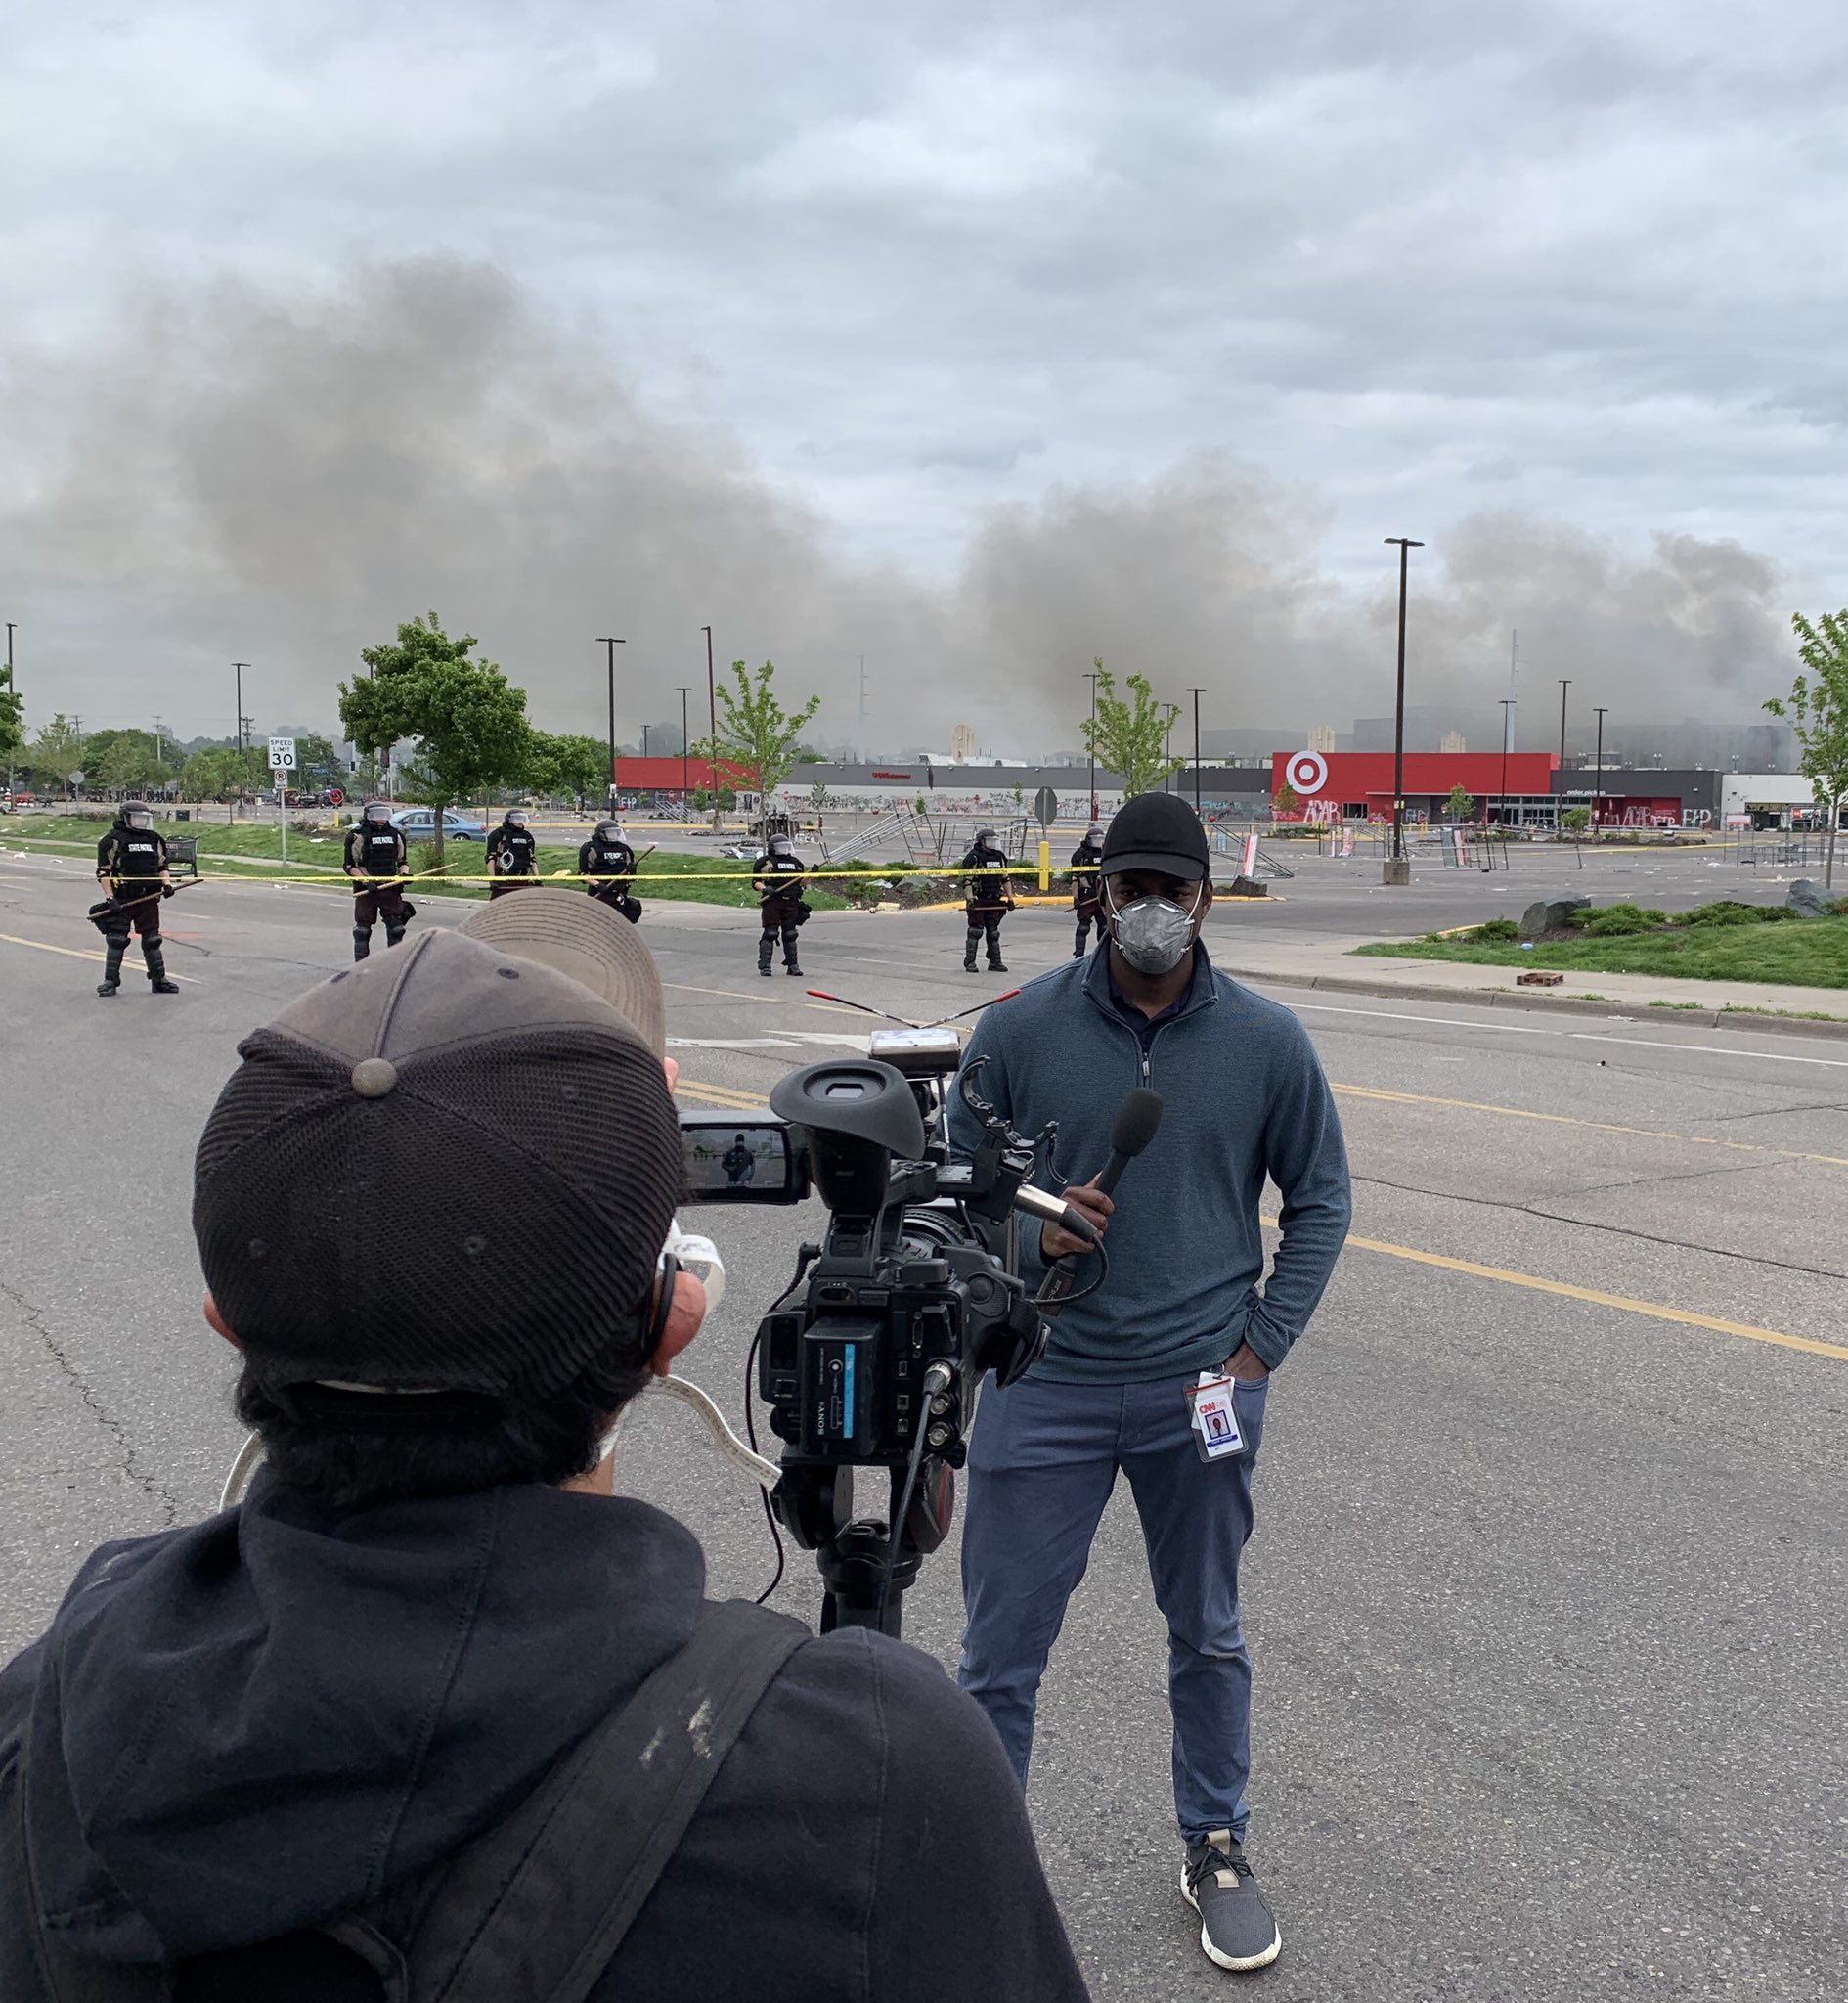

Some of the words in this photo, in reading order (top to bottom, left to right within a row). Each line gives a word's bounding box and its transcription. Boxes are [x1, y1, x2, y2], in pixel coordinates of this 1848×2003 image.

[272, 753, 293, 766] 30
[140, 843, 154, 852] PATROL
[1199, 1402, 1216, 1414] CNN
